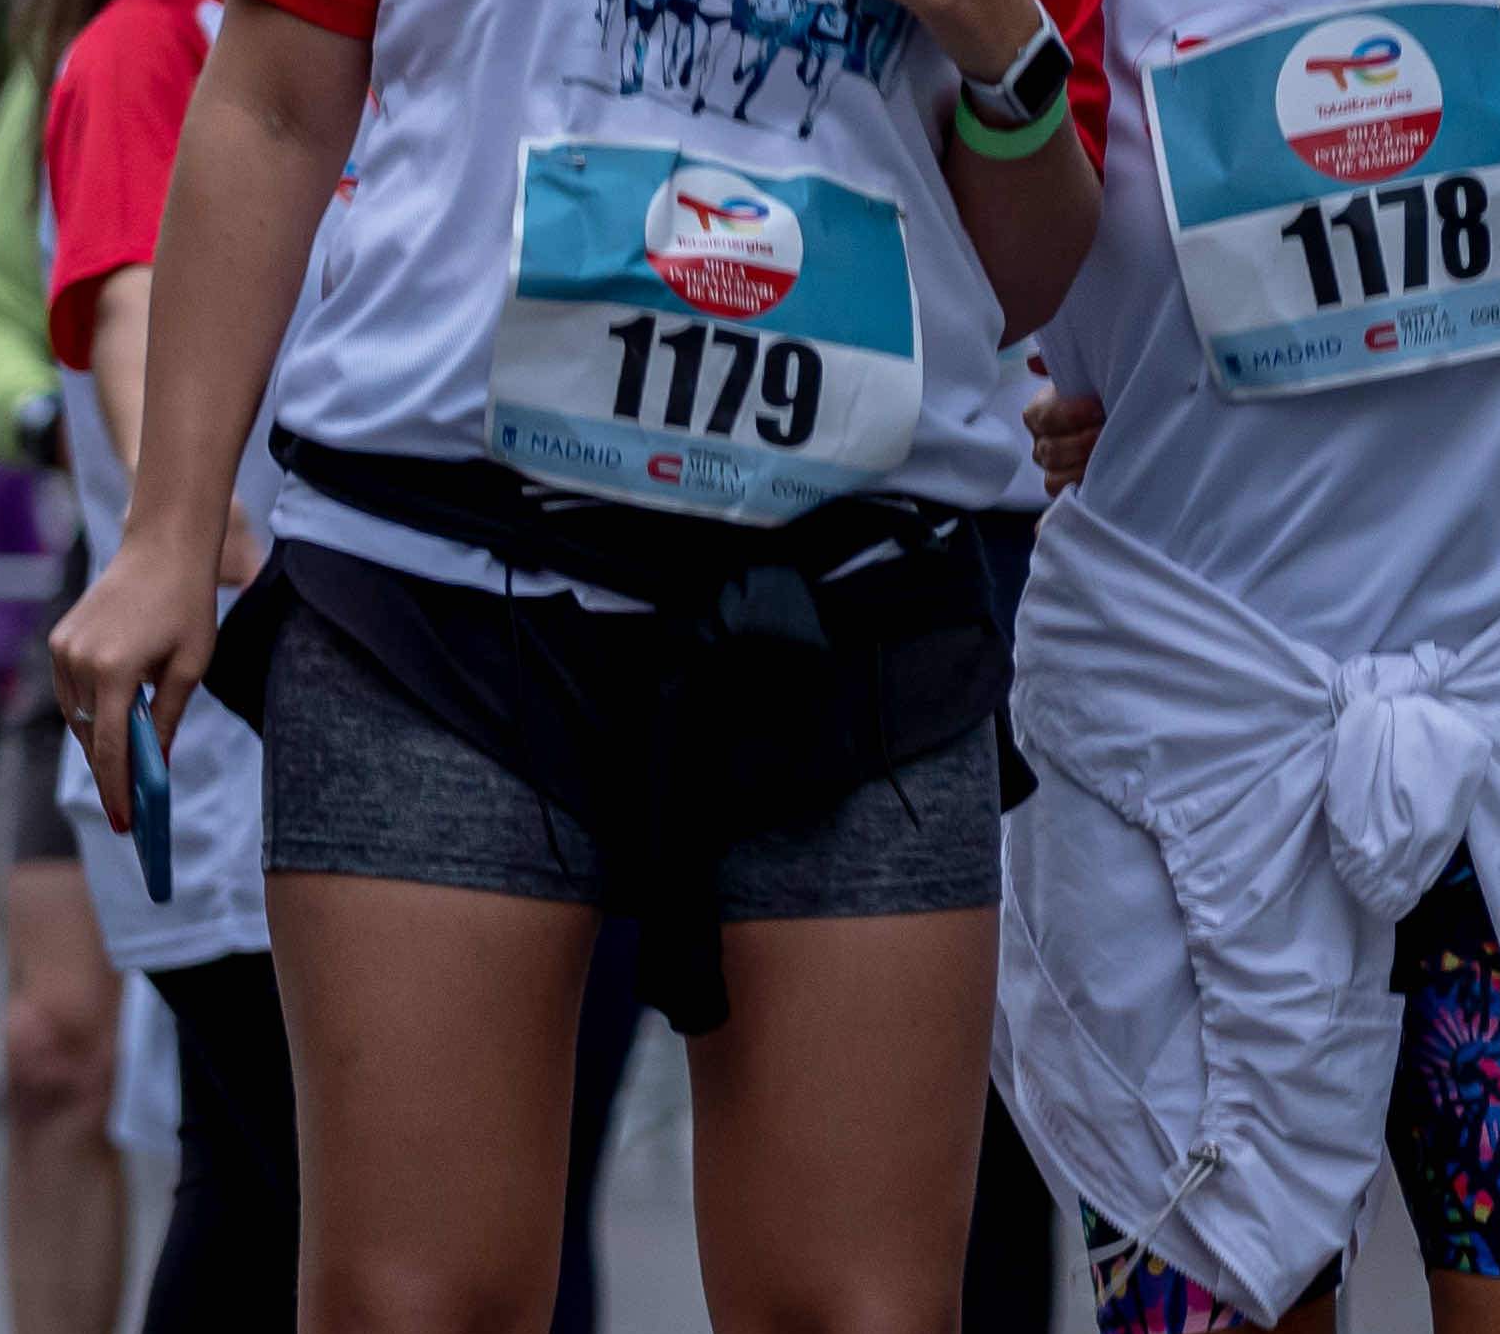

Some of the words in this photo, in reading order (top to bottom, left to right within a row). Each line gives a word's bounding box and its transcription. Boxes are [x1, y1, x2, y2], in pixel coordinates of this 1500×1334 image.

[1281, 175, 1492, 311] 1178
[609, 315, 823, 447] 1179
[1252, 334, 1344, 371] MADRID
[531, 430, 622, 468] MADRID
